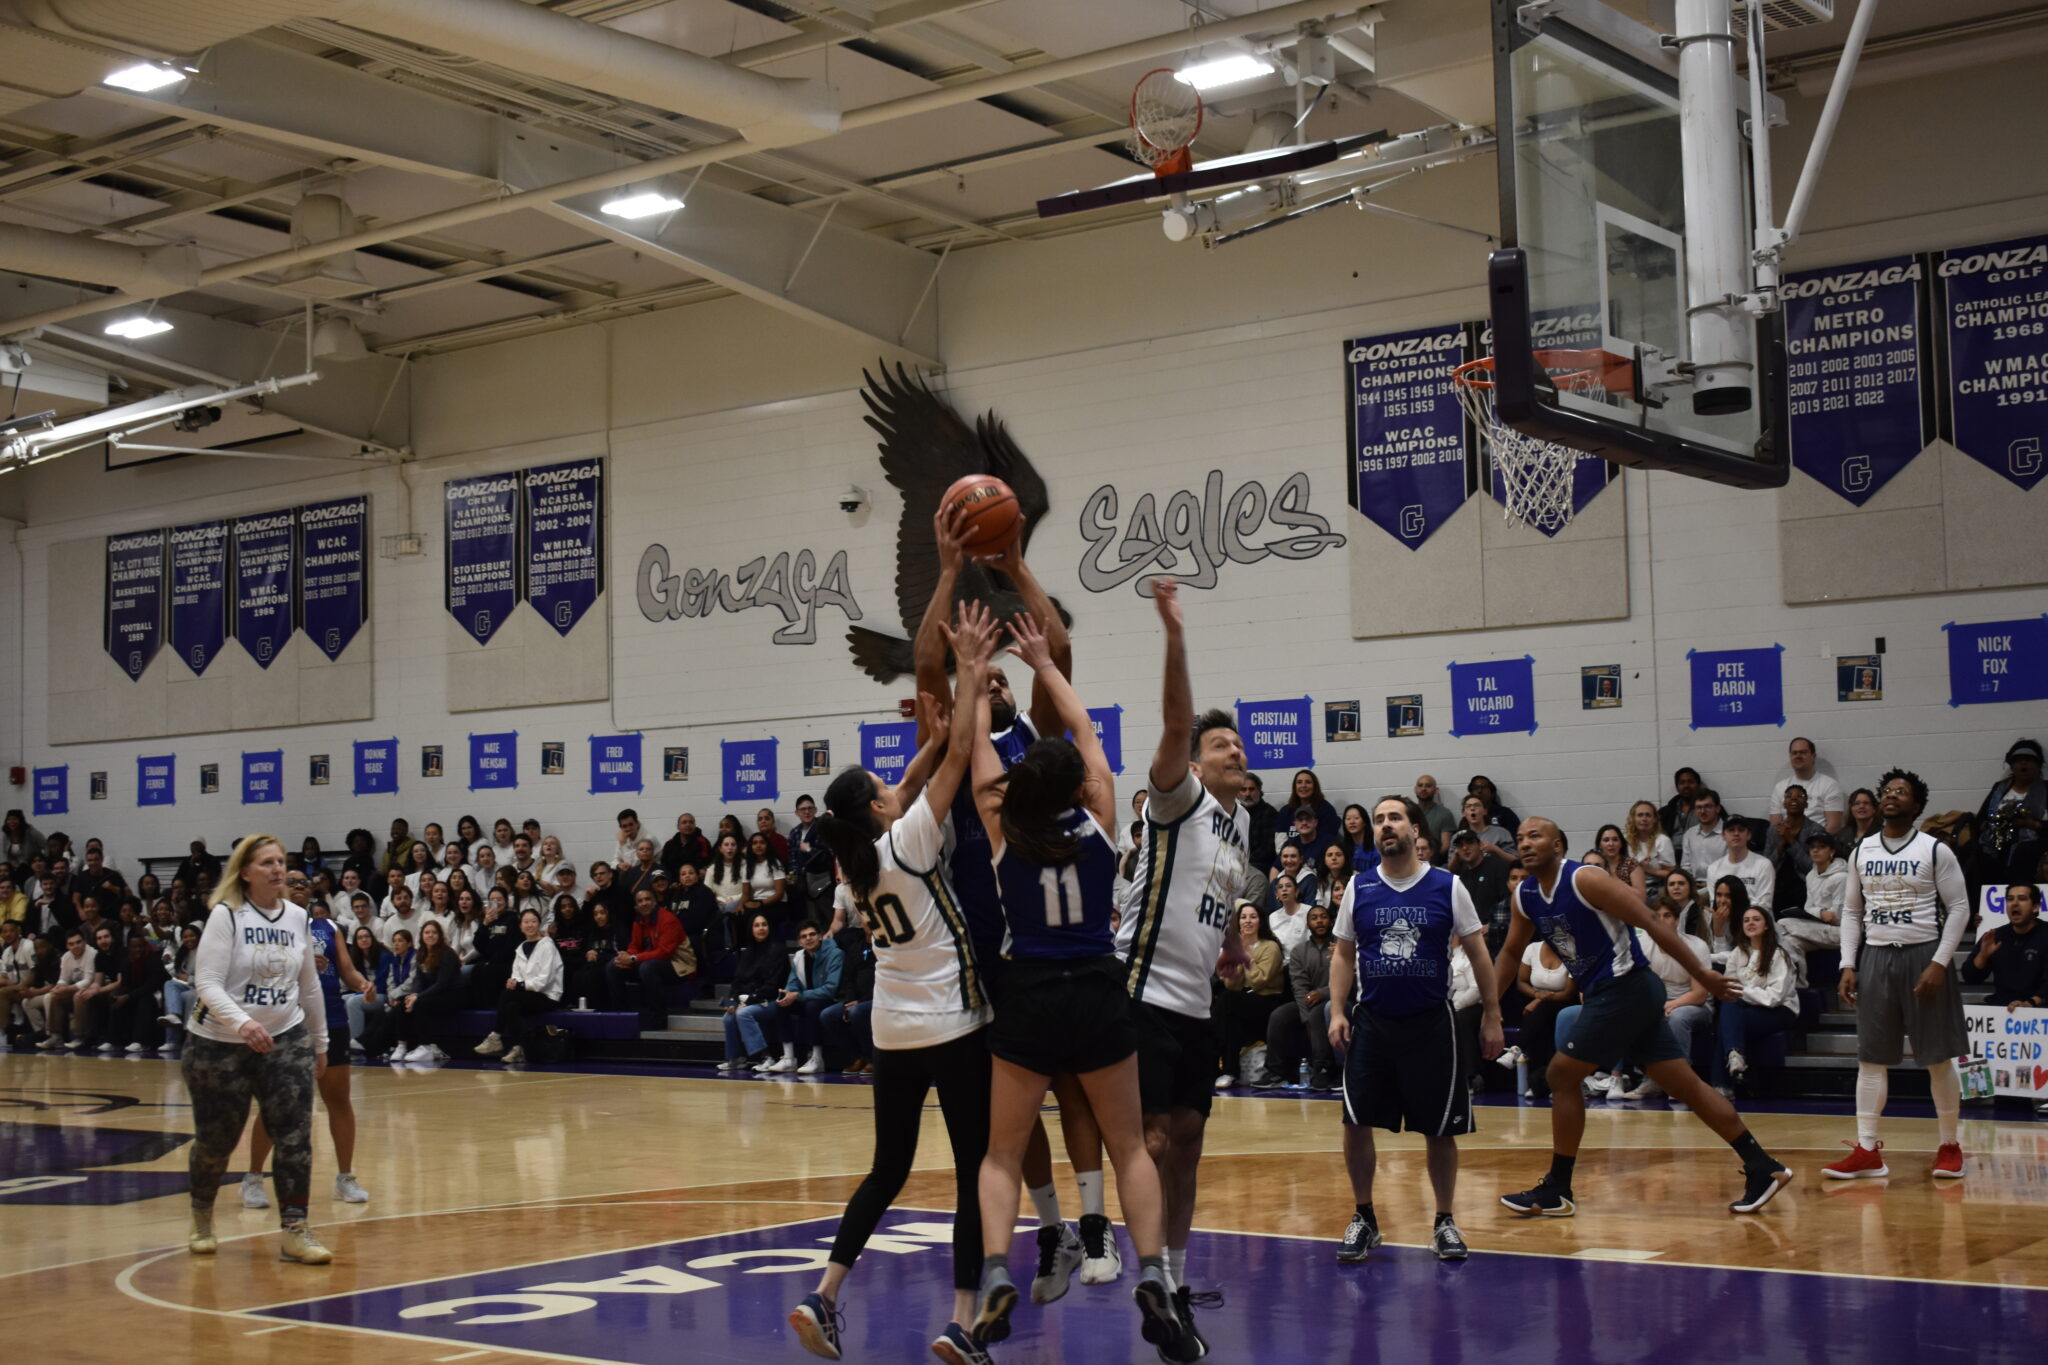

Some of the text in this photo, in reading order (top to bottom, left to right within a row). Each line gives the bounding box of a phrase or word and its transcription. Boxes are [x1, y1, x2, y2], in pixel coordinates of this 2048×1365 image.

[1779, 263, 1922, 301] GONZAGA
[1987, 266, 2043, 284] GOLF
[1823, 290, 1875, 306] GOLF
[1955, 295, 2022, 313] CATHOLIC
[1815, 308, 1884, 331] METRO
[1538, 330, 1600, 348] COUNTRY
[1993, 323, 2045, 340] 1968
[1348, 331, 1468, 363] GONZAGA
[1789, 324, 1913, 355] CHAMPIONS
[1370, 353, 1446, 371] FOOTBALL
[1789, 348, 1915, 377] 2001 2002 2003 2006
[1361, 366, 1455, 388] CHAMPIONS
[1790, 368, 1916, 396] 2007 2011 2012 2017
[1358, 383, 1434, 405] 1944 1945 1946
[1997, 390, 2048, 406] 1991
[1384, 401, 1435, 417] 1955 1959
[1791, 390, 1884, 415] 2019 2021 2022
[1385, 426, 1434, 441] WCAC
[1363, 436, 1458, 457] CHAMPIONS
[1359, 448, 1463, 472] 1996 1997 2002 2018
[525, 465, 600, 487] GONZAGA
[447, 478, 517, 500] GONZAGA
[548, 482, 578, 493] CREW
[468, 495, 496, 505] CREW
[540, 492, 584, 506] NCASRA
[301, 503, 365, 523] GONZAGA
[457, 505, 507, 519] NATIONAL
[533, 501, 592, 516] CHAMPIONS
[234, 514, 295, 535] GONZAGA
[307, 517, 358, 530] BASKETBALL
[454, 513, 511, 528] CHAMPIONS
[535, 515, 591, 532] 2002 2004
[171, 526, 228, 544] GONZAGA
[240, 528, 288, 541] BASKETBALL
[109, 535, 164, 552] GONZAGA
[178, 540, 220, 551] BASEBALL
[317, 536, 348, 550] WCAC
[543, 538, 582, 551] WMIRA
[176, 554, 222, 567] CHAMPIONS
[240, 551, 289, 567] CHAMPIONS
[305, 550, 361, 567] CHAMPIONS
[533, 547, 592, 561] CHAMPIONS
[128, 558, 142, 569] CITY
[143, 555, 160, 567] TITLE
[454, 560, 511, 575] STOTESBURY
[112, 567, 161, 582] CHAMPIONS
[186, 573, 211, 583] WCAC
[454, 571, 510, 584] CHAMPIONS
[115, 585, 156, 597] BASKETBALL
[175, 581, 222, 593] CHAMPIONS
[250, 585, 277, 597] WMAC
[240, 594, 288, 608] CHAMPIONS
[120, 622, 152, 632] FOOTBALL
[1977, 635, 2012, 653] NICK
[1717, 662, 1745, 678] PETE
[1982, 658, 2008, 675] FOX
[1477, 677, 1498, 692] TAL
[1713, 680, 1755, 696] BARON
[1980, 680, 1999, 692] #7
[1467, 695, 1514, 712] VICARIO
[1718, 701, 1743, 713] #13
[1251, 712, 1297, 726] CRISTIAN
[1479, 714, 1500, 725] #22
[875, 735, 901, 749] REILLY
[1254, 731, 1298, 745] COLWELL
[484, 742, 500, 753] NATE
[1264, 749, 1284, 759] #33
[480, 757, 507, 768] MENSAH
[599, 762, 633, 773] WILLIAMS
[740, 754, 755, 766] JOE
[874, 755, 904, 768] WRIGHT
[736, 770, 767, 782] PATRICK
[1865, 861, 1920, 876] ROWDY
[1038, 863, 1084, 926] 11
[855, 893, 916, 947] 20
[1375, 907, 1427, 925] HOYA
[1871, 909, 1912, 924] REVS
[245, 927, 295, 948] ROWDY
[2005, 1018, 2048, 1035] COURT
[1973, 1041, 2041, 1059] LEGEND
